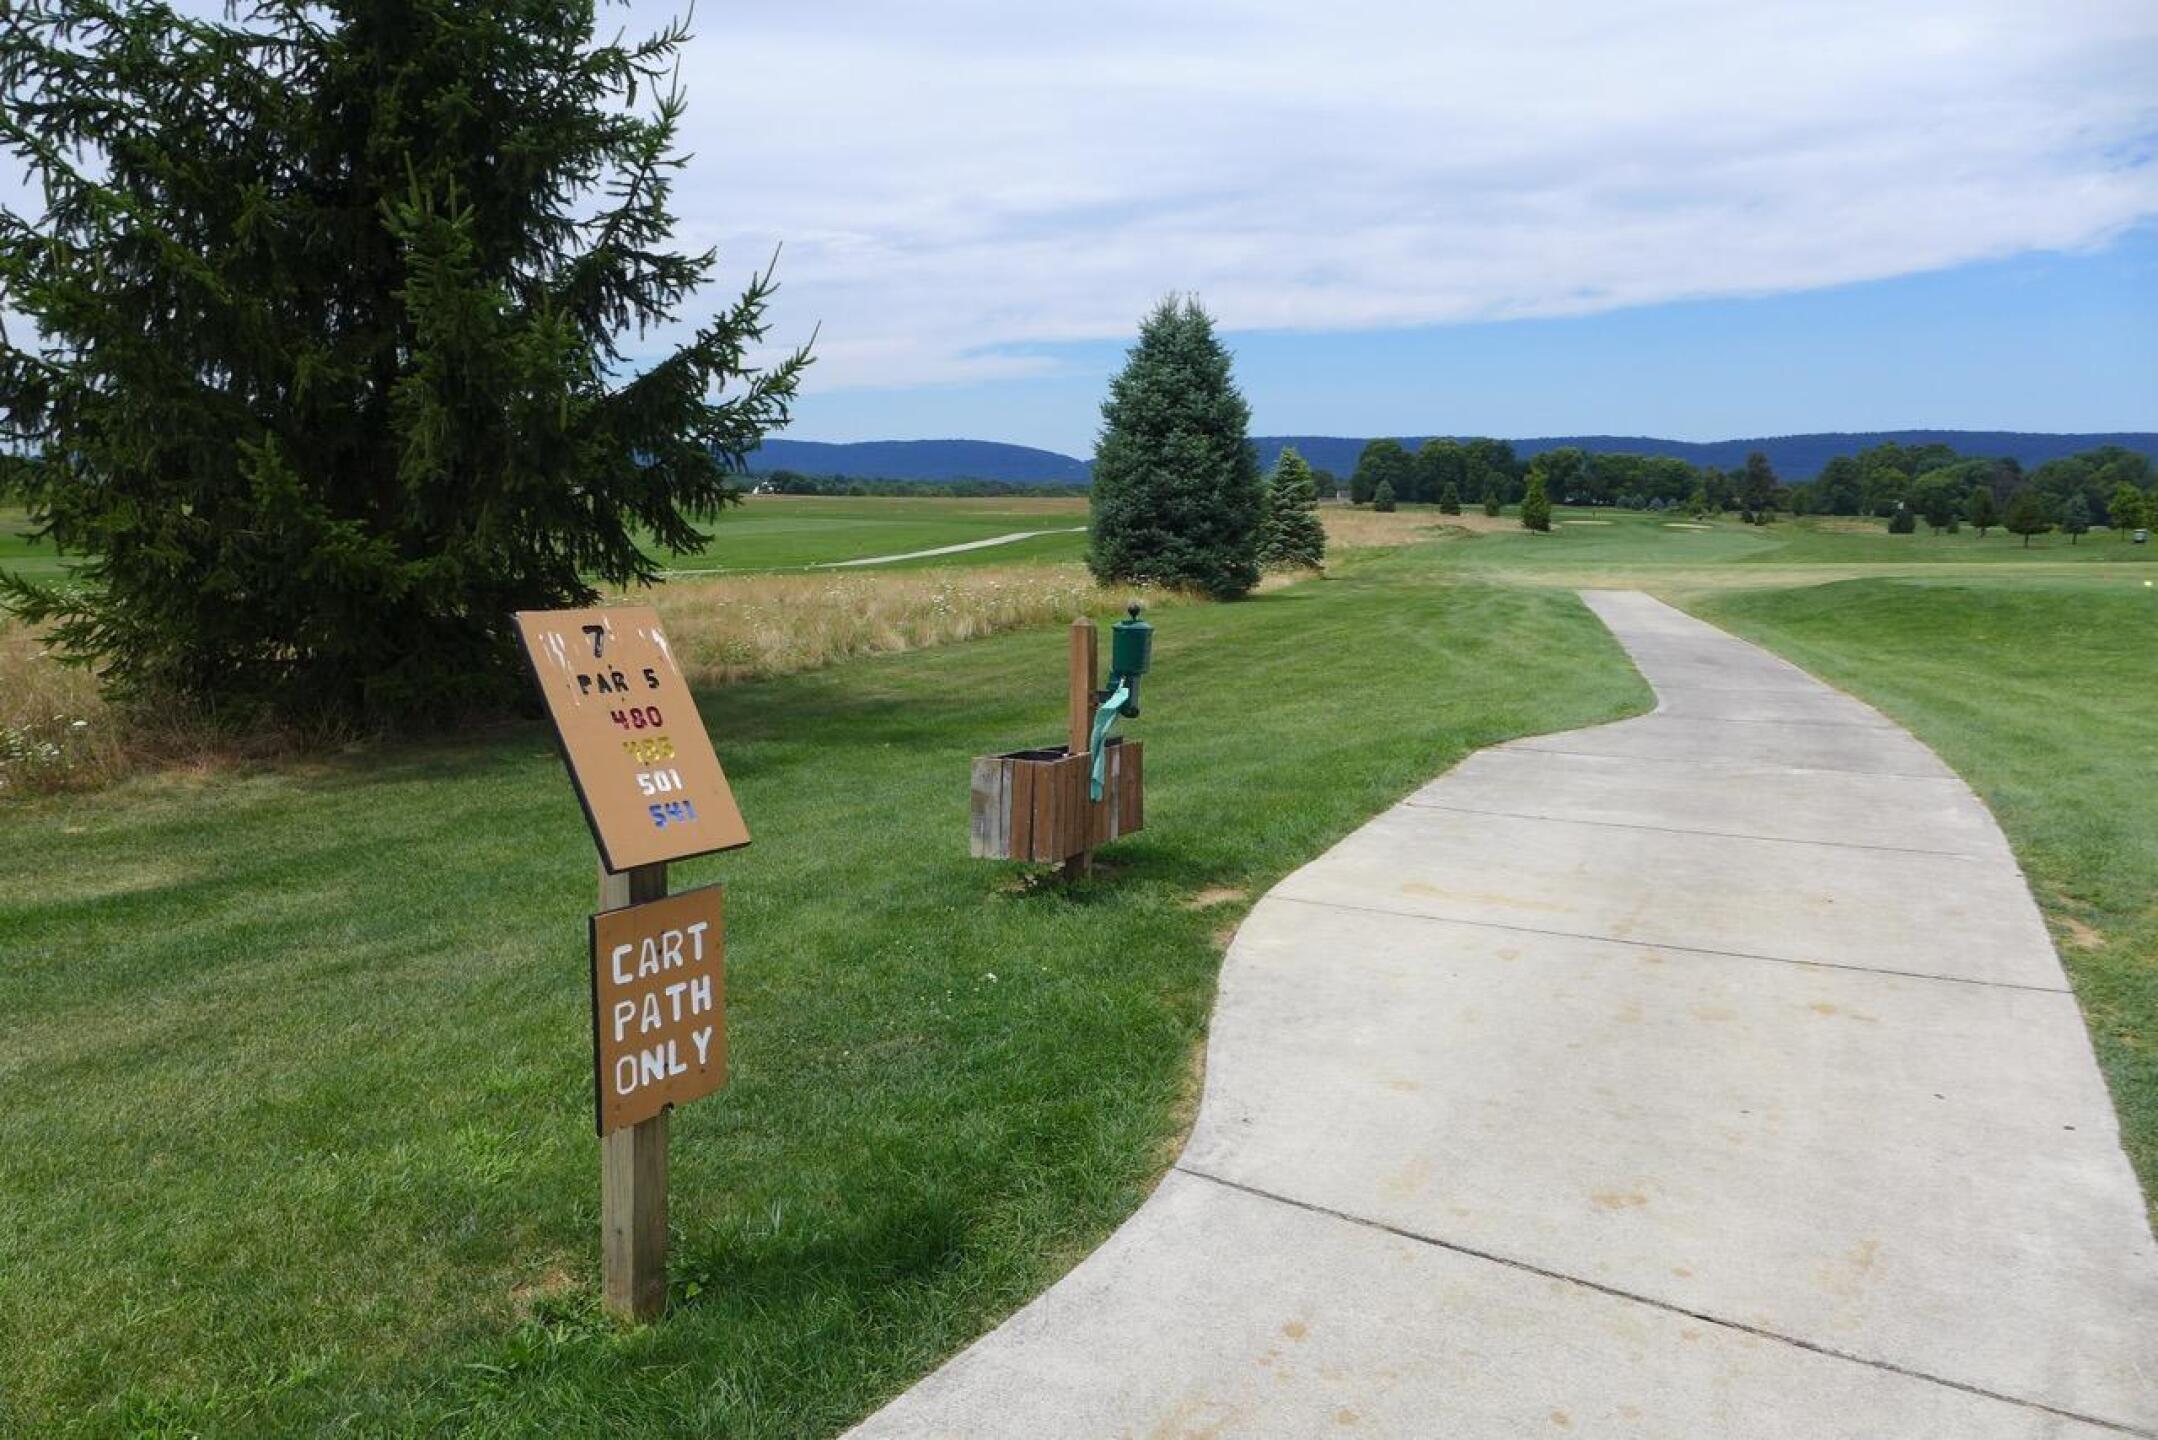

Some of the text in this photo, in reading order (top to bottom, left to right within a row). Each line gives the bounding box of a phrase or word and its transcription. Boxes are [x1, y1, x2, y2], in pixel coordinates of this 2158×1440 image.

[581, 625, 604, 658] 7
[576, 668, 660, 695] PAR 5
[610, 706, 664, 730] 480
[635, 768, 683, 795] 501
[611, 921, 708, 985] CART
[614, 974, 713, 1042] PATH
[615, 1026, 713, 1096] ONLY
